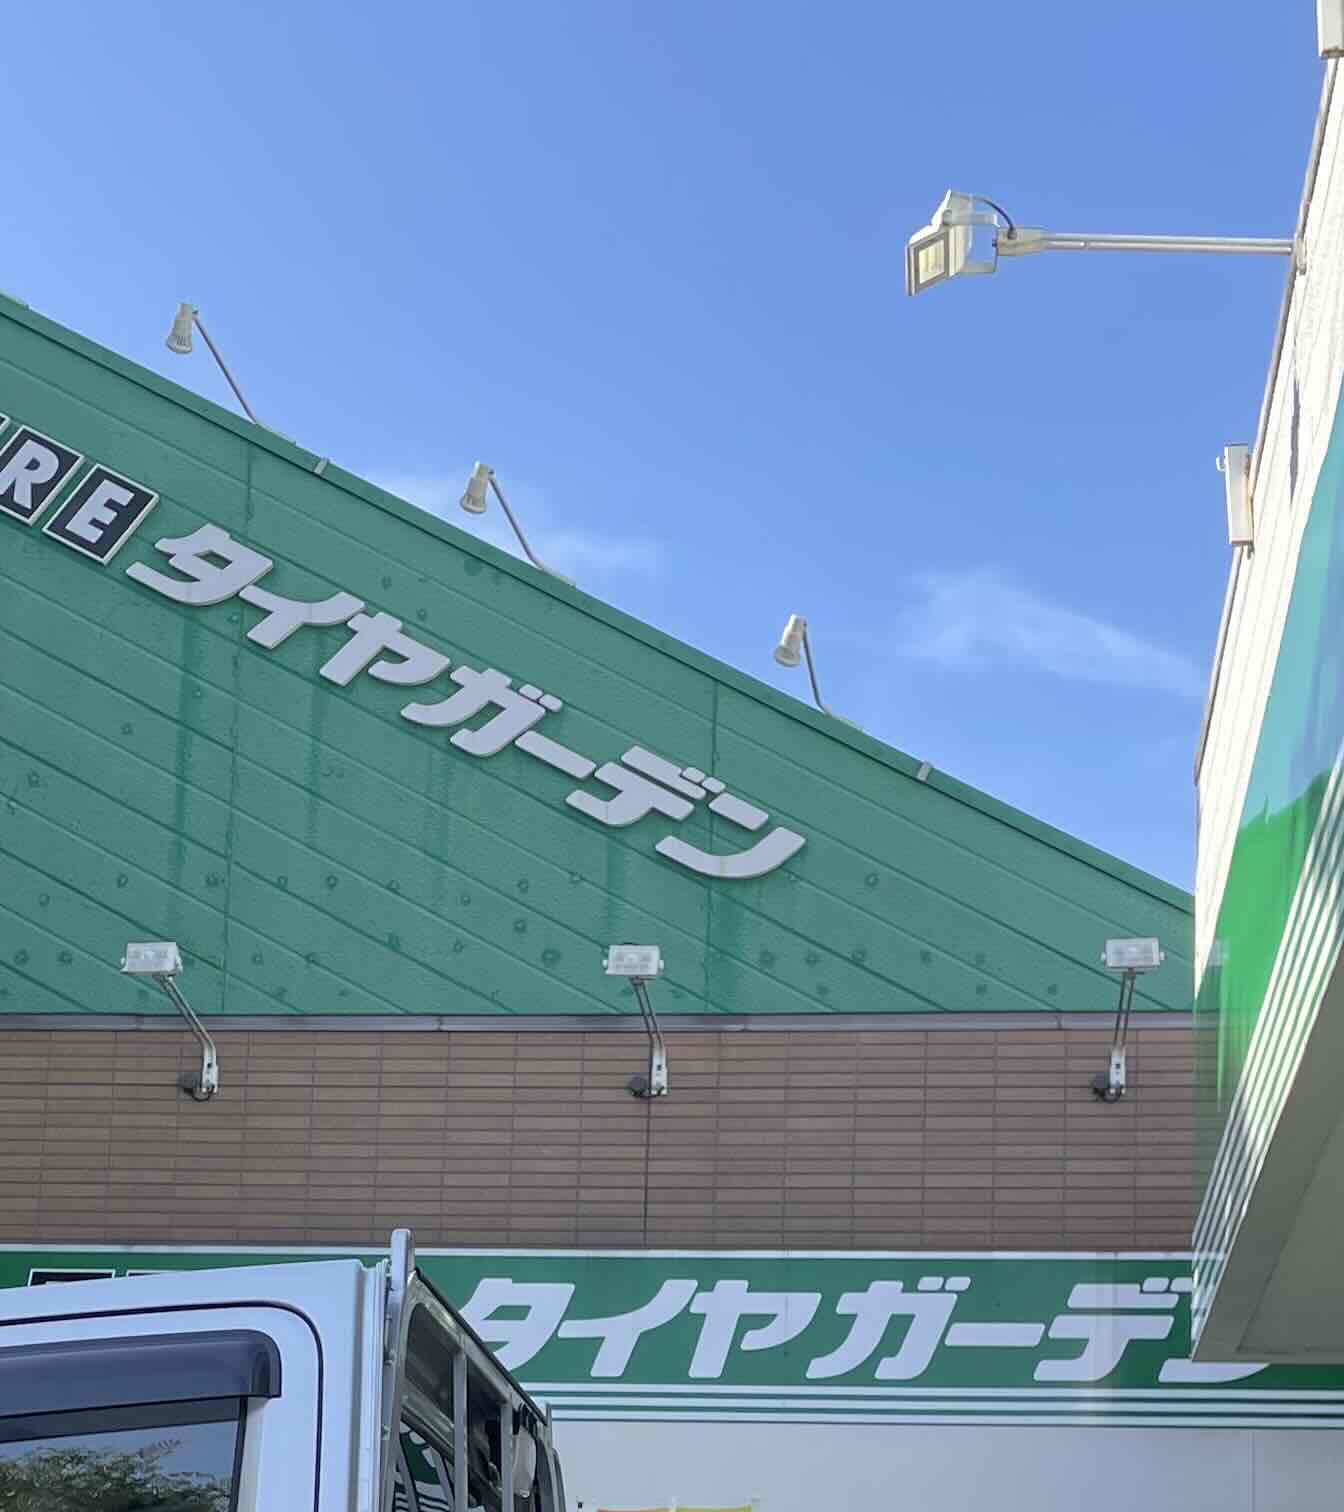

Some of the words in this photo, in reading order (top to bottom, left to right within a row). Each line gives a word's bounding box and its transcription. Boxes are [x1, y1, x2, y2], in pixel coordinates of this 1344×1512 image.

[125, 523, 806, 881] タイヤガーデン
